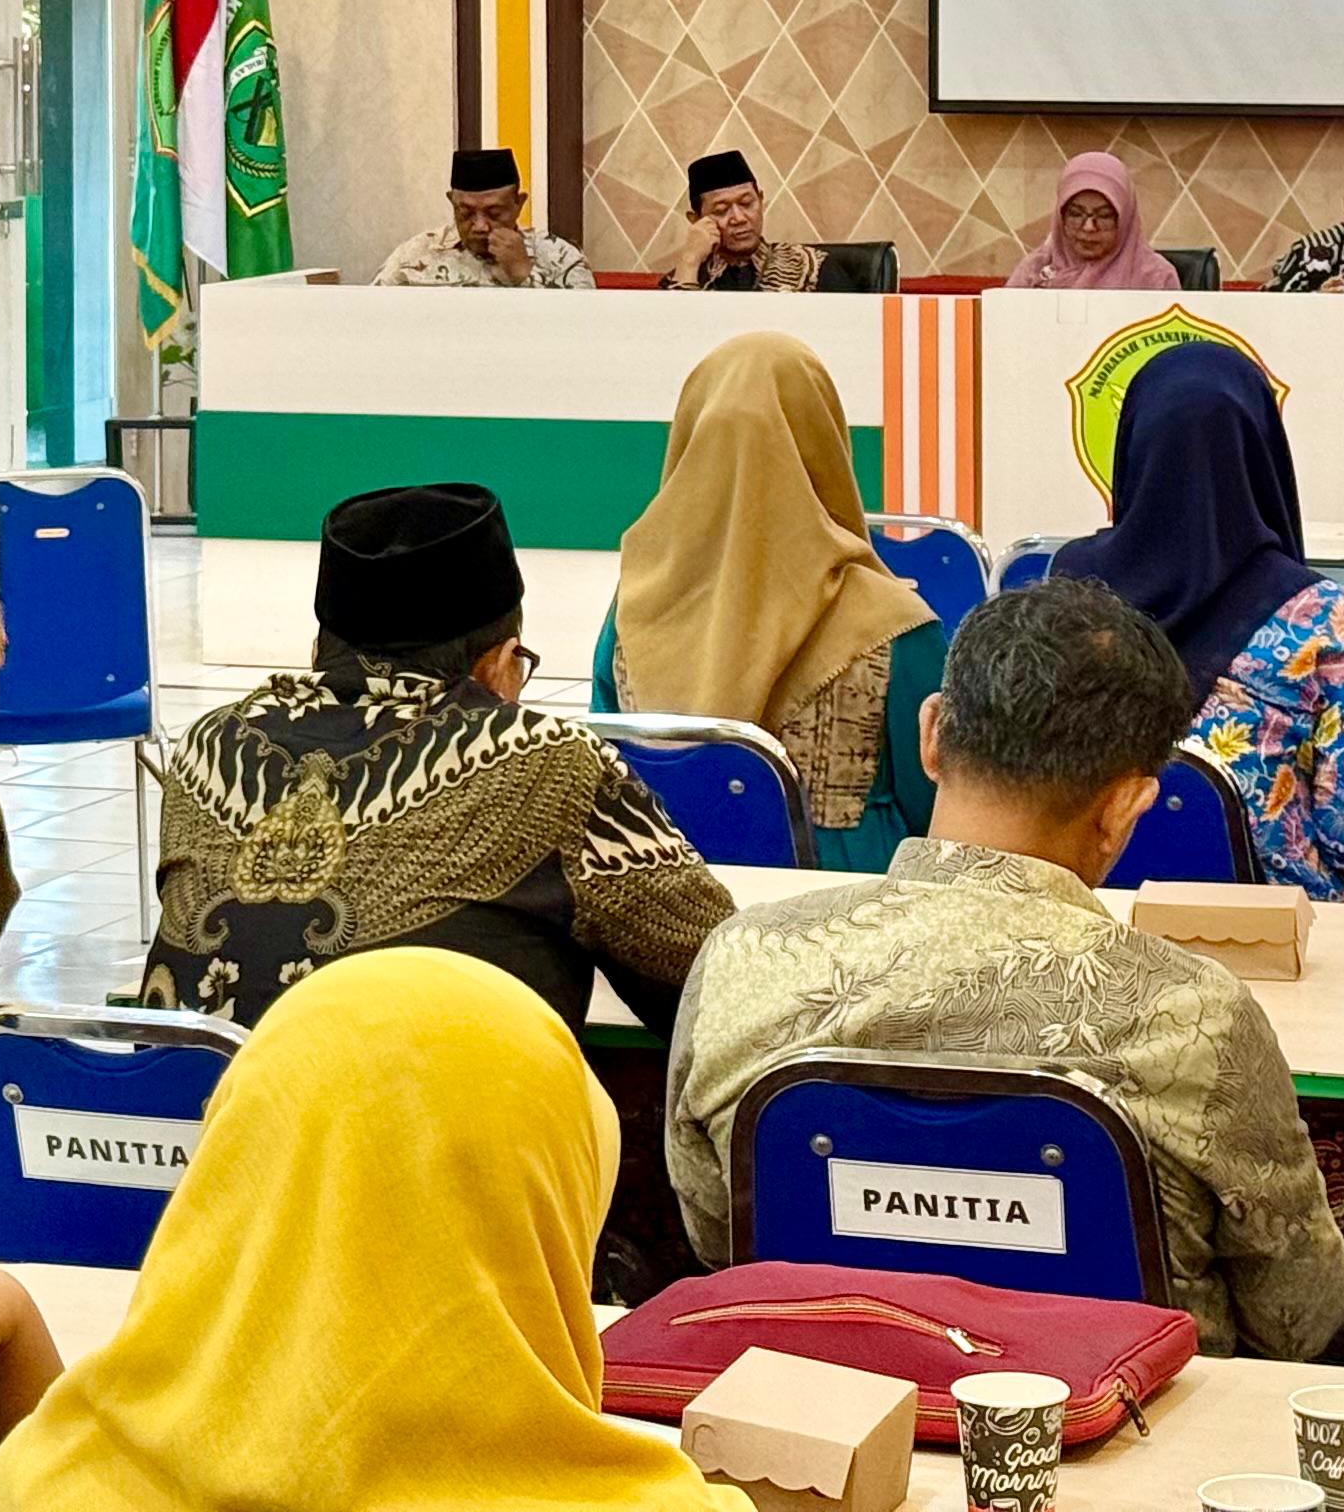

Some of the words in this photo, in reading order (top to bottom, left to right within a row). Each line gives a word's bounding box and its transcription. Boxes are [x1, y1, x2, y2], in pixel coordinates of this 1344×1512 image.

[45, 1134, 190, 1168] PANITIA
[863, 1188, 1031, 1225] PANITIA
[1004, 1434, 1062, 1473] Good
